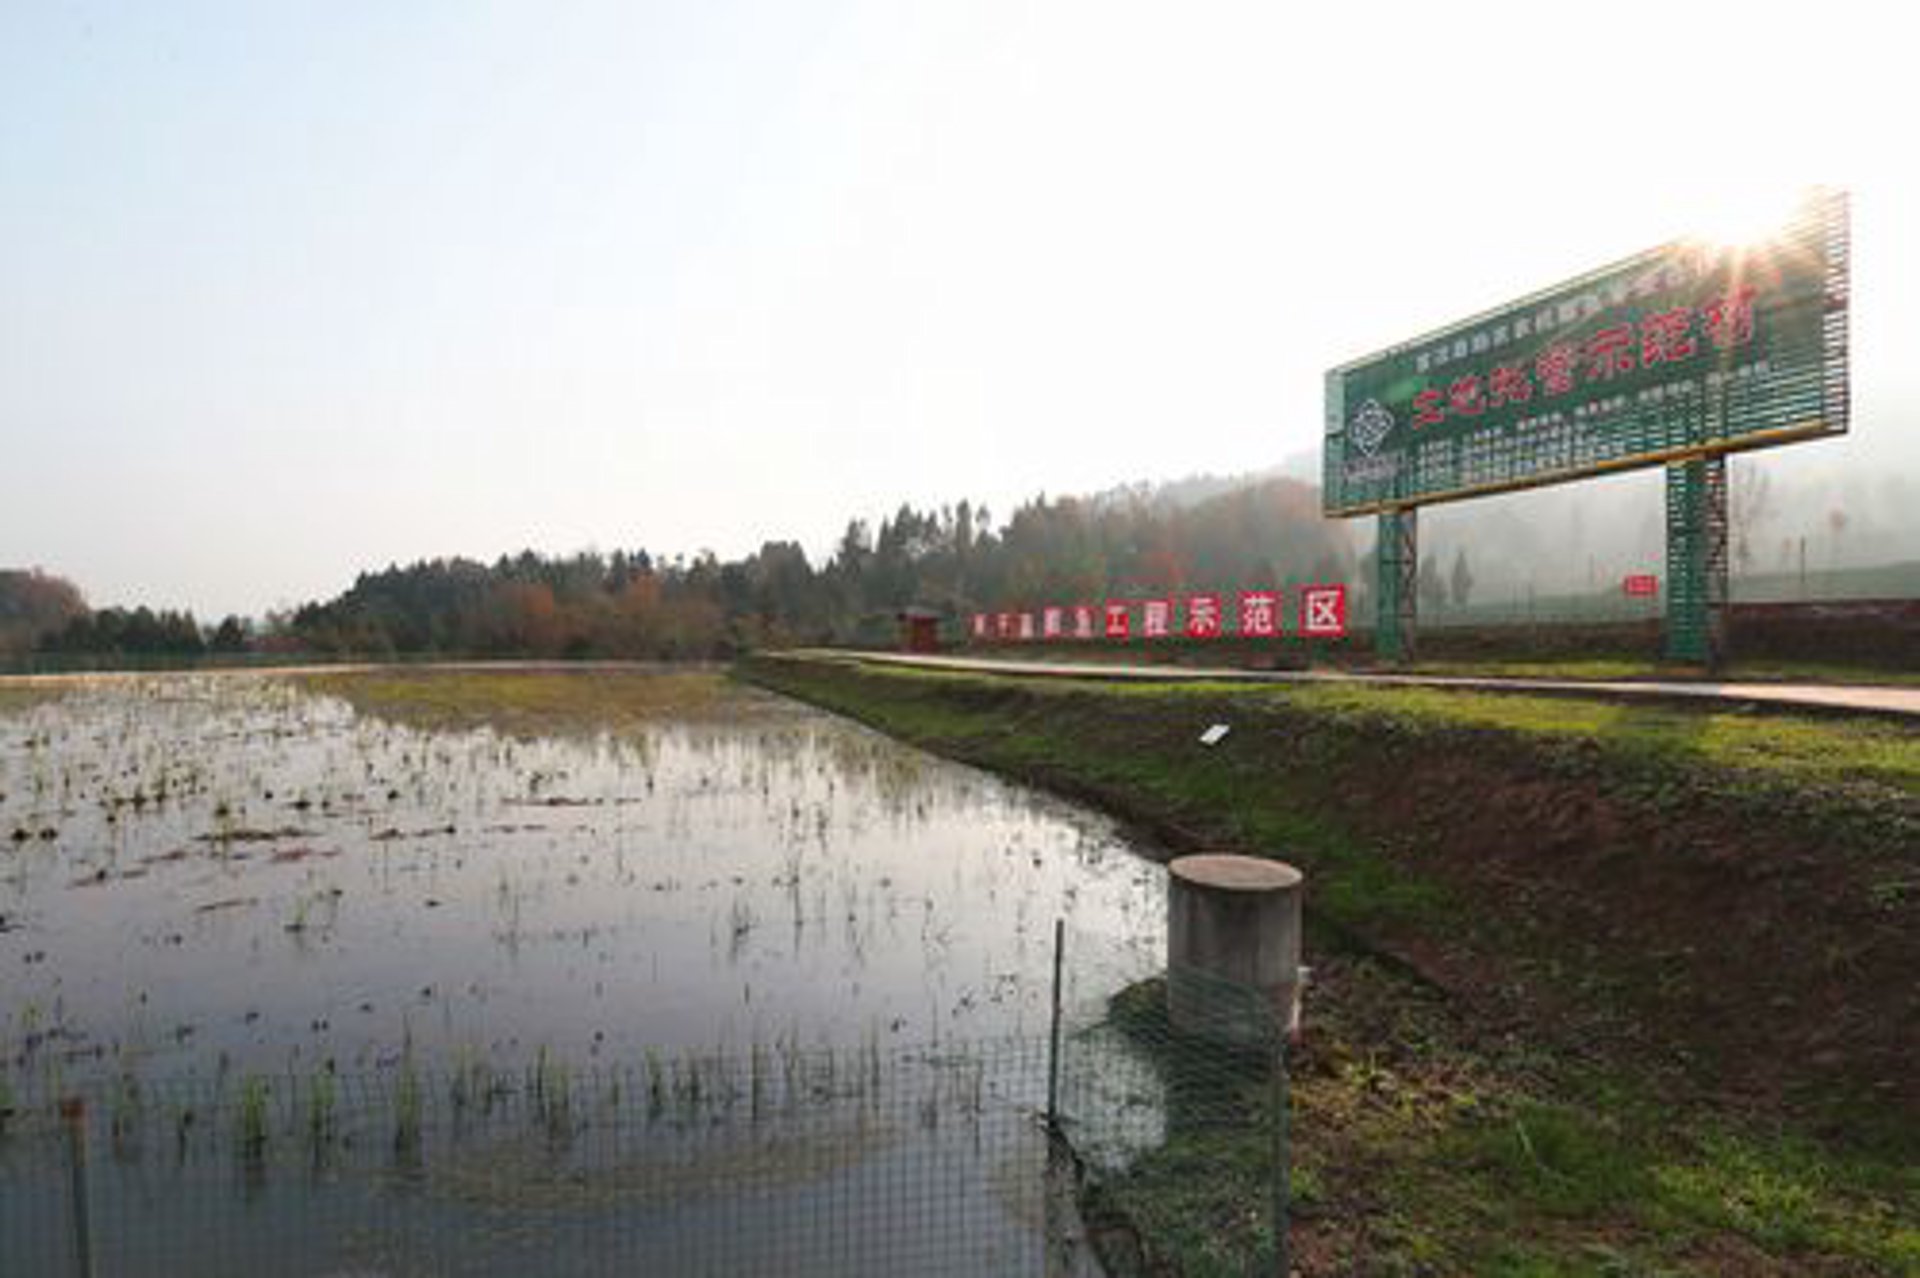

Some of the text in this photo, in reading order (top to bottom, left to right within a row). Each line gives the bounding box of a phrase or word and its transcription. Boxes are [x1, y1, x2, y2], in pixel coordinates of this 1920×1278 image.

[974, 589, 1342, 638] 工程示范区
